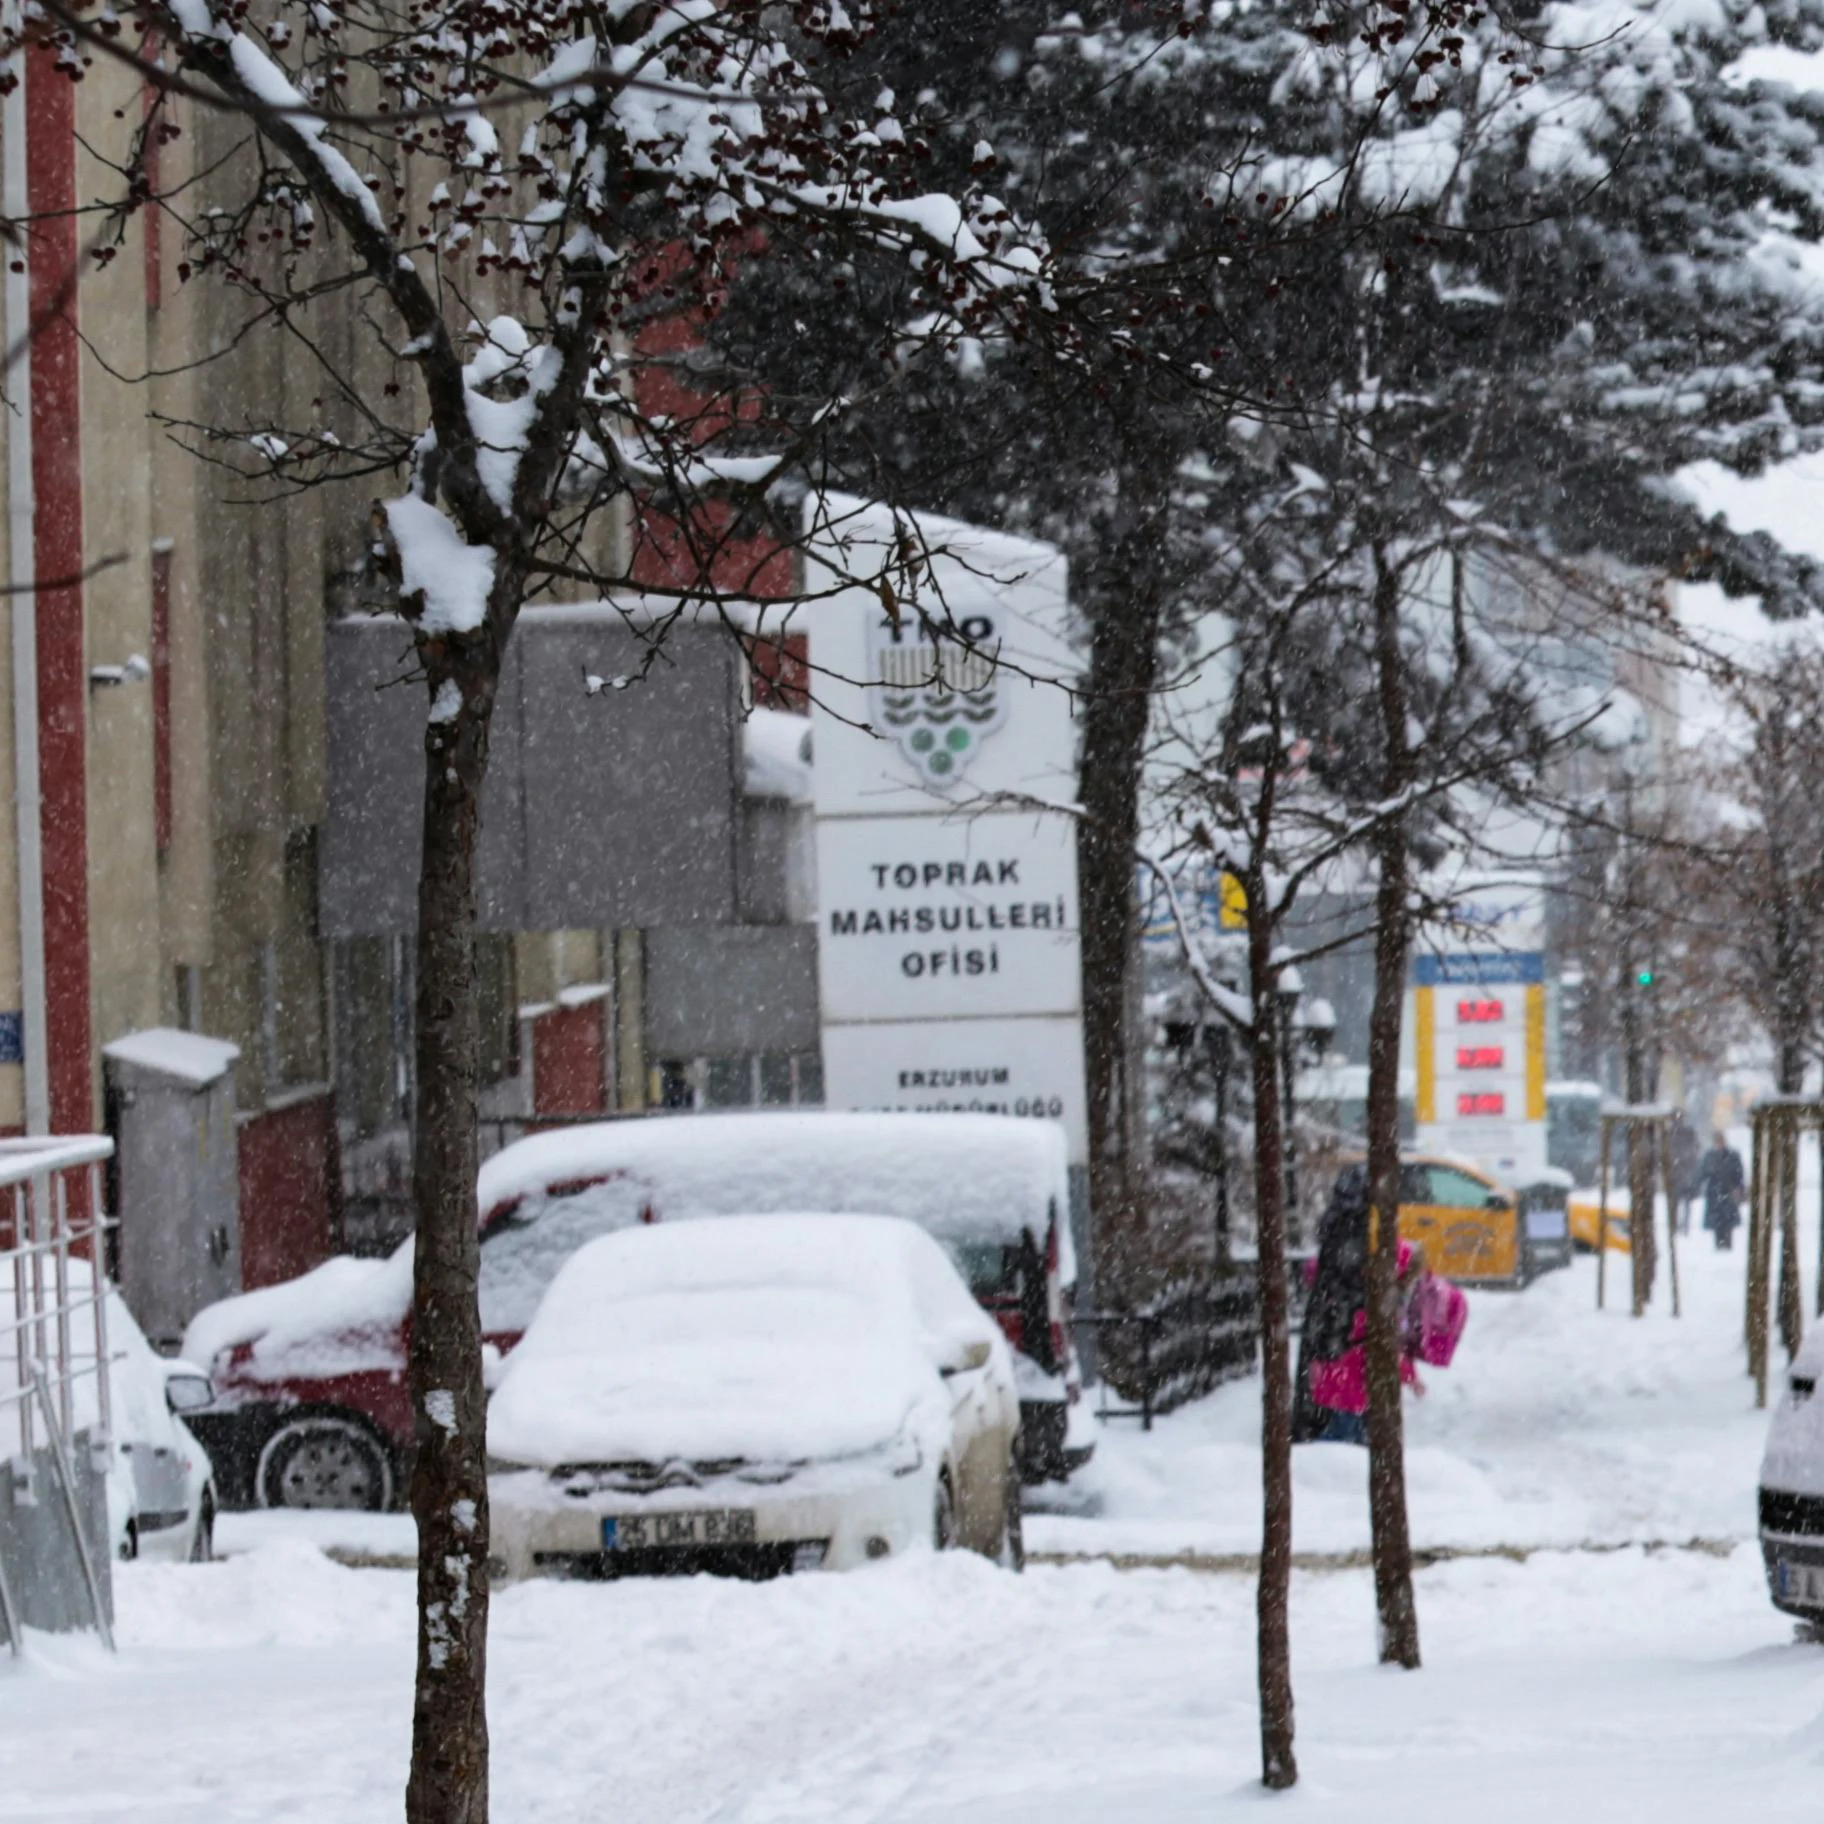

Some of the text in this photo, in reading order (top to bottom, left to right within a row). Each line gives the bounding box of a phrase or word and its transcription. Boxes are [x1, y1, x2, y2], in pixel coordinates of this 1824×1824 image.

[872, 859, 1021, 889] TOPRAK
[830, 895, 1066, 935] MAHSULLERİ
[902, 942, 1001, 978] OFİSİ
[898, 1066, 1010, 1088] ERZURUM
